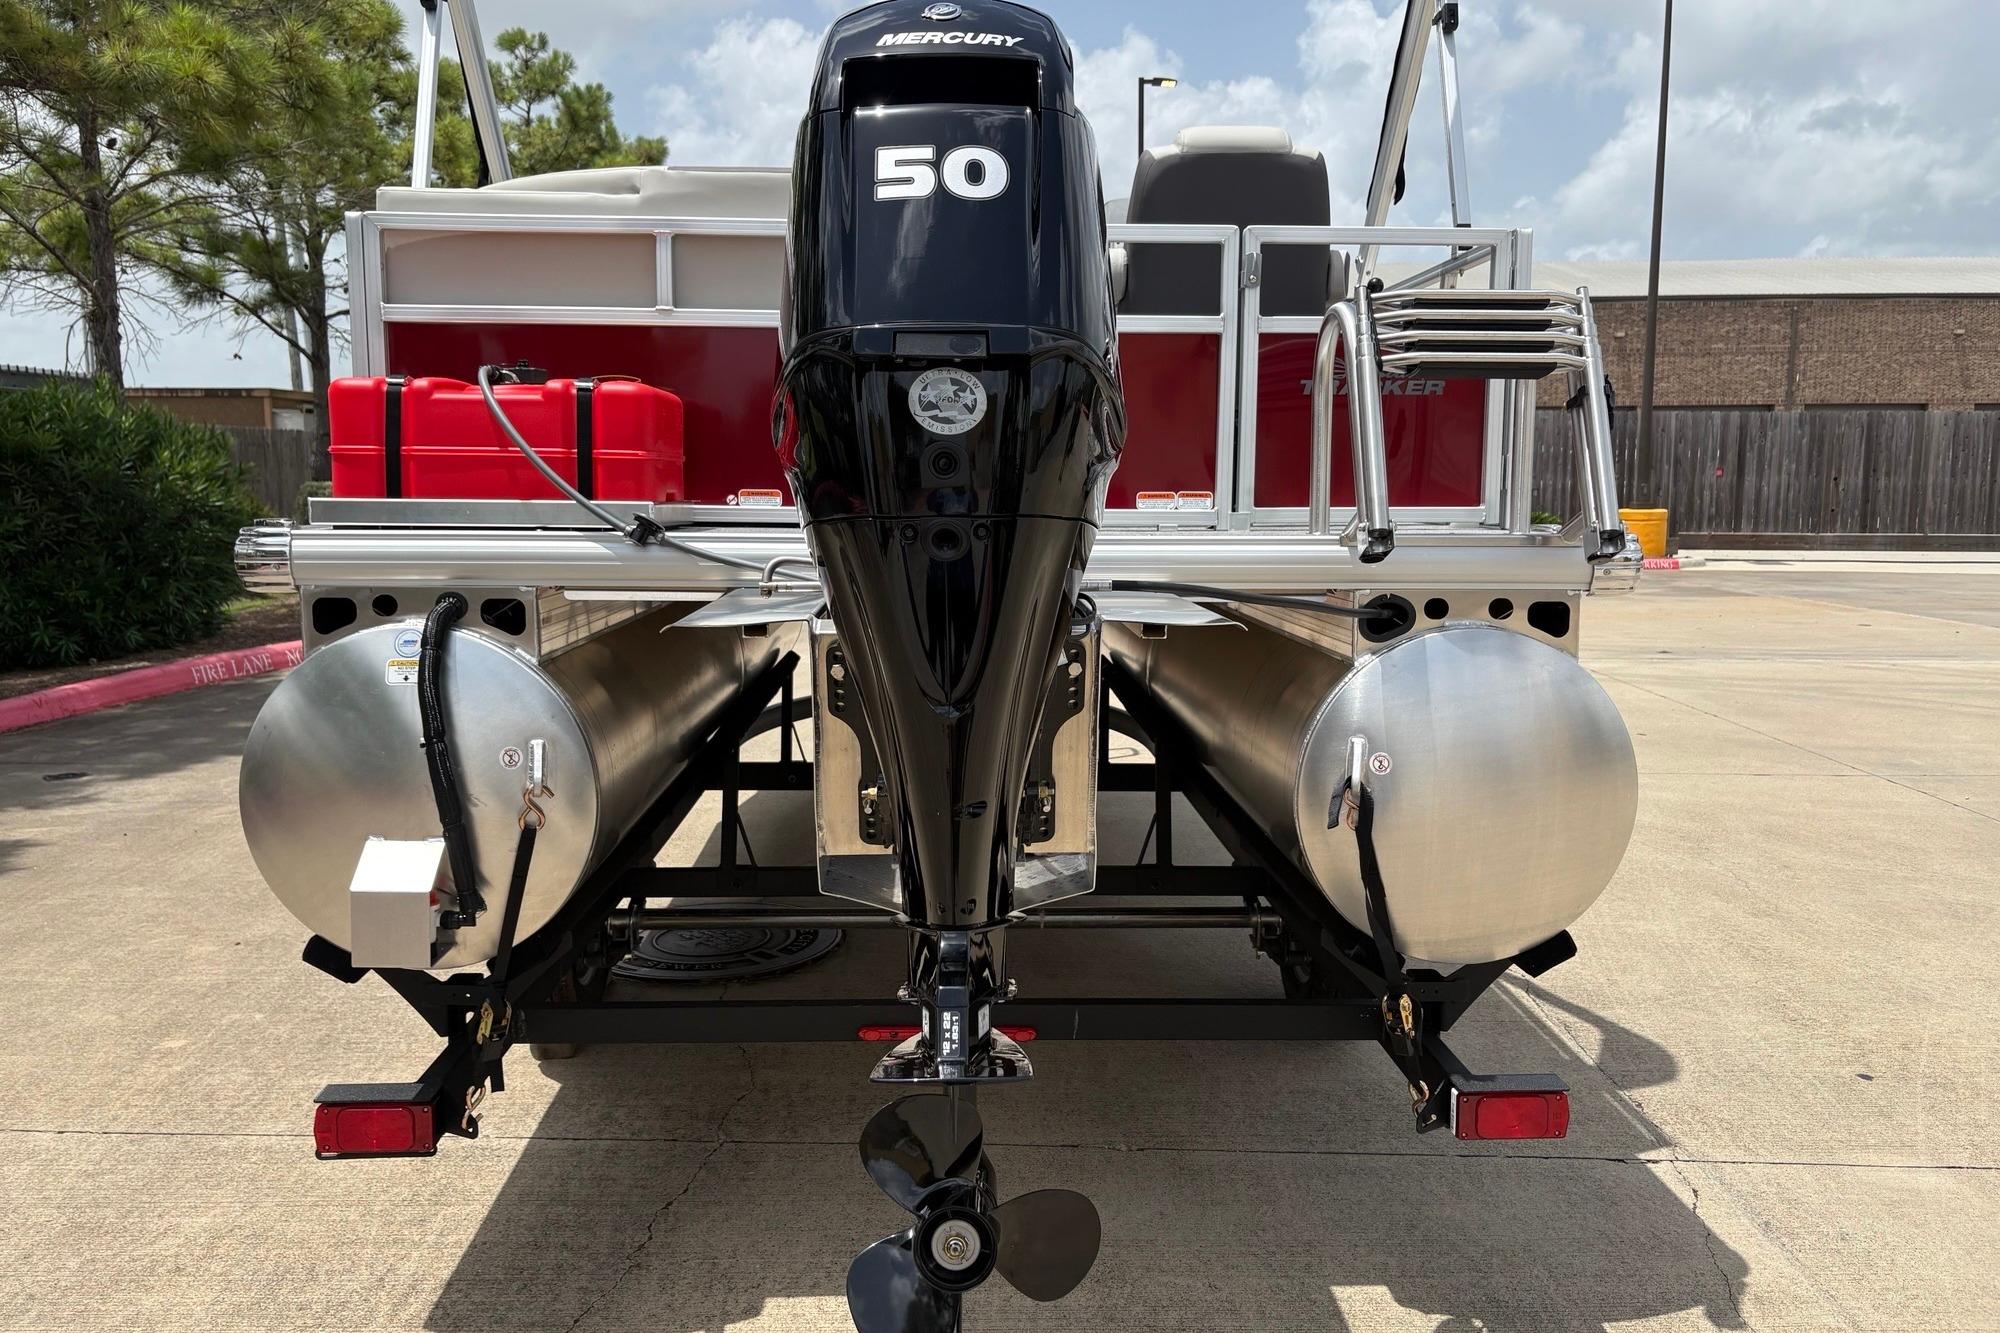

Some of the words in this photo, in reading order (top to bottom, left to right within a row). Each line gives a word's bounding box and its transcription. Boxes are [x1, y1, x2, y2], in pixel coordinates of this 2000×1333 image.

[875, 31, 1024, 47] MERCURY
[874, 144, 1010, 201] 50
[960, 372, 981, 390] LOW
[1300, 380, 1446, 396] TKER
[1643, 559, 1673, 569] RKING
[191, 662, 229, 684] FIRE
[231, 653, 273, 677] LANE
[645, 960, 724, 970] SEWER
[943, 1011, 951, 1029] 22
[943, 1041, 951, 1056] 12
